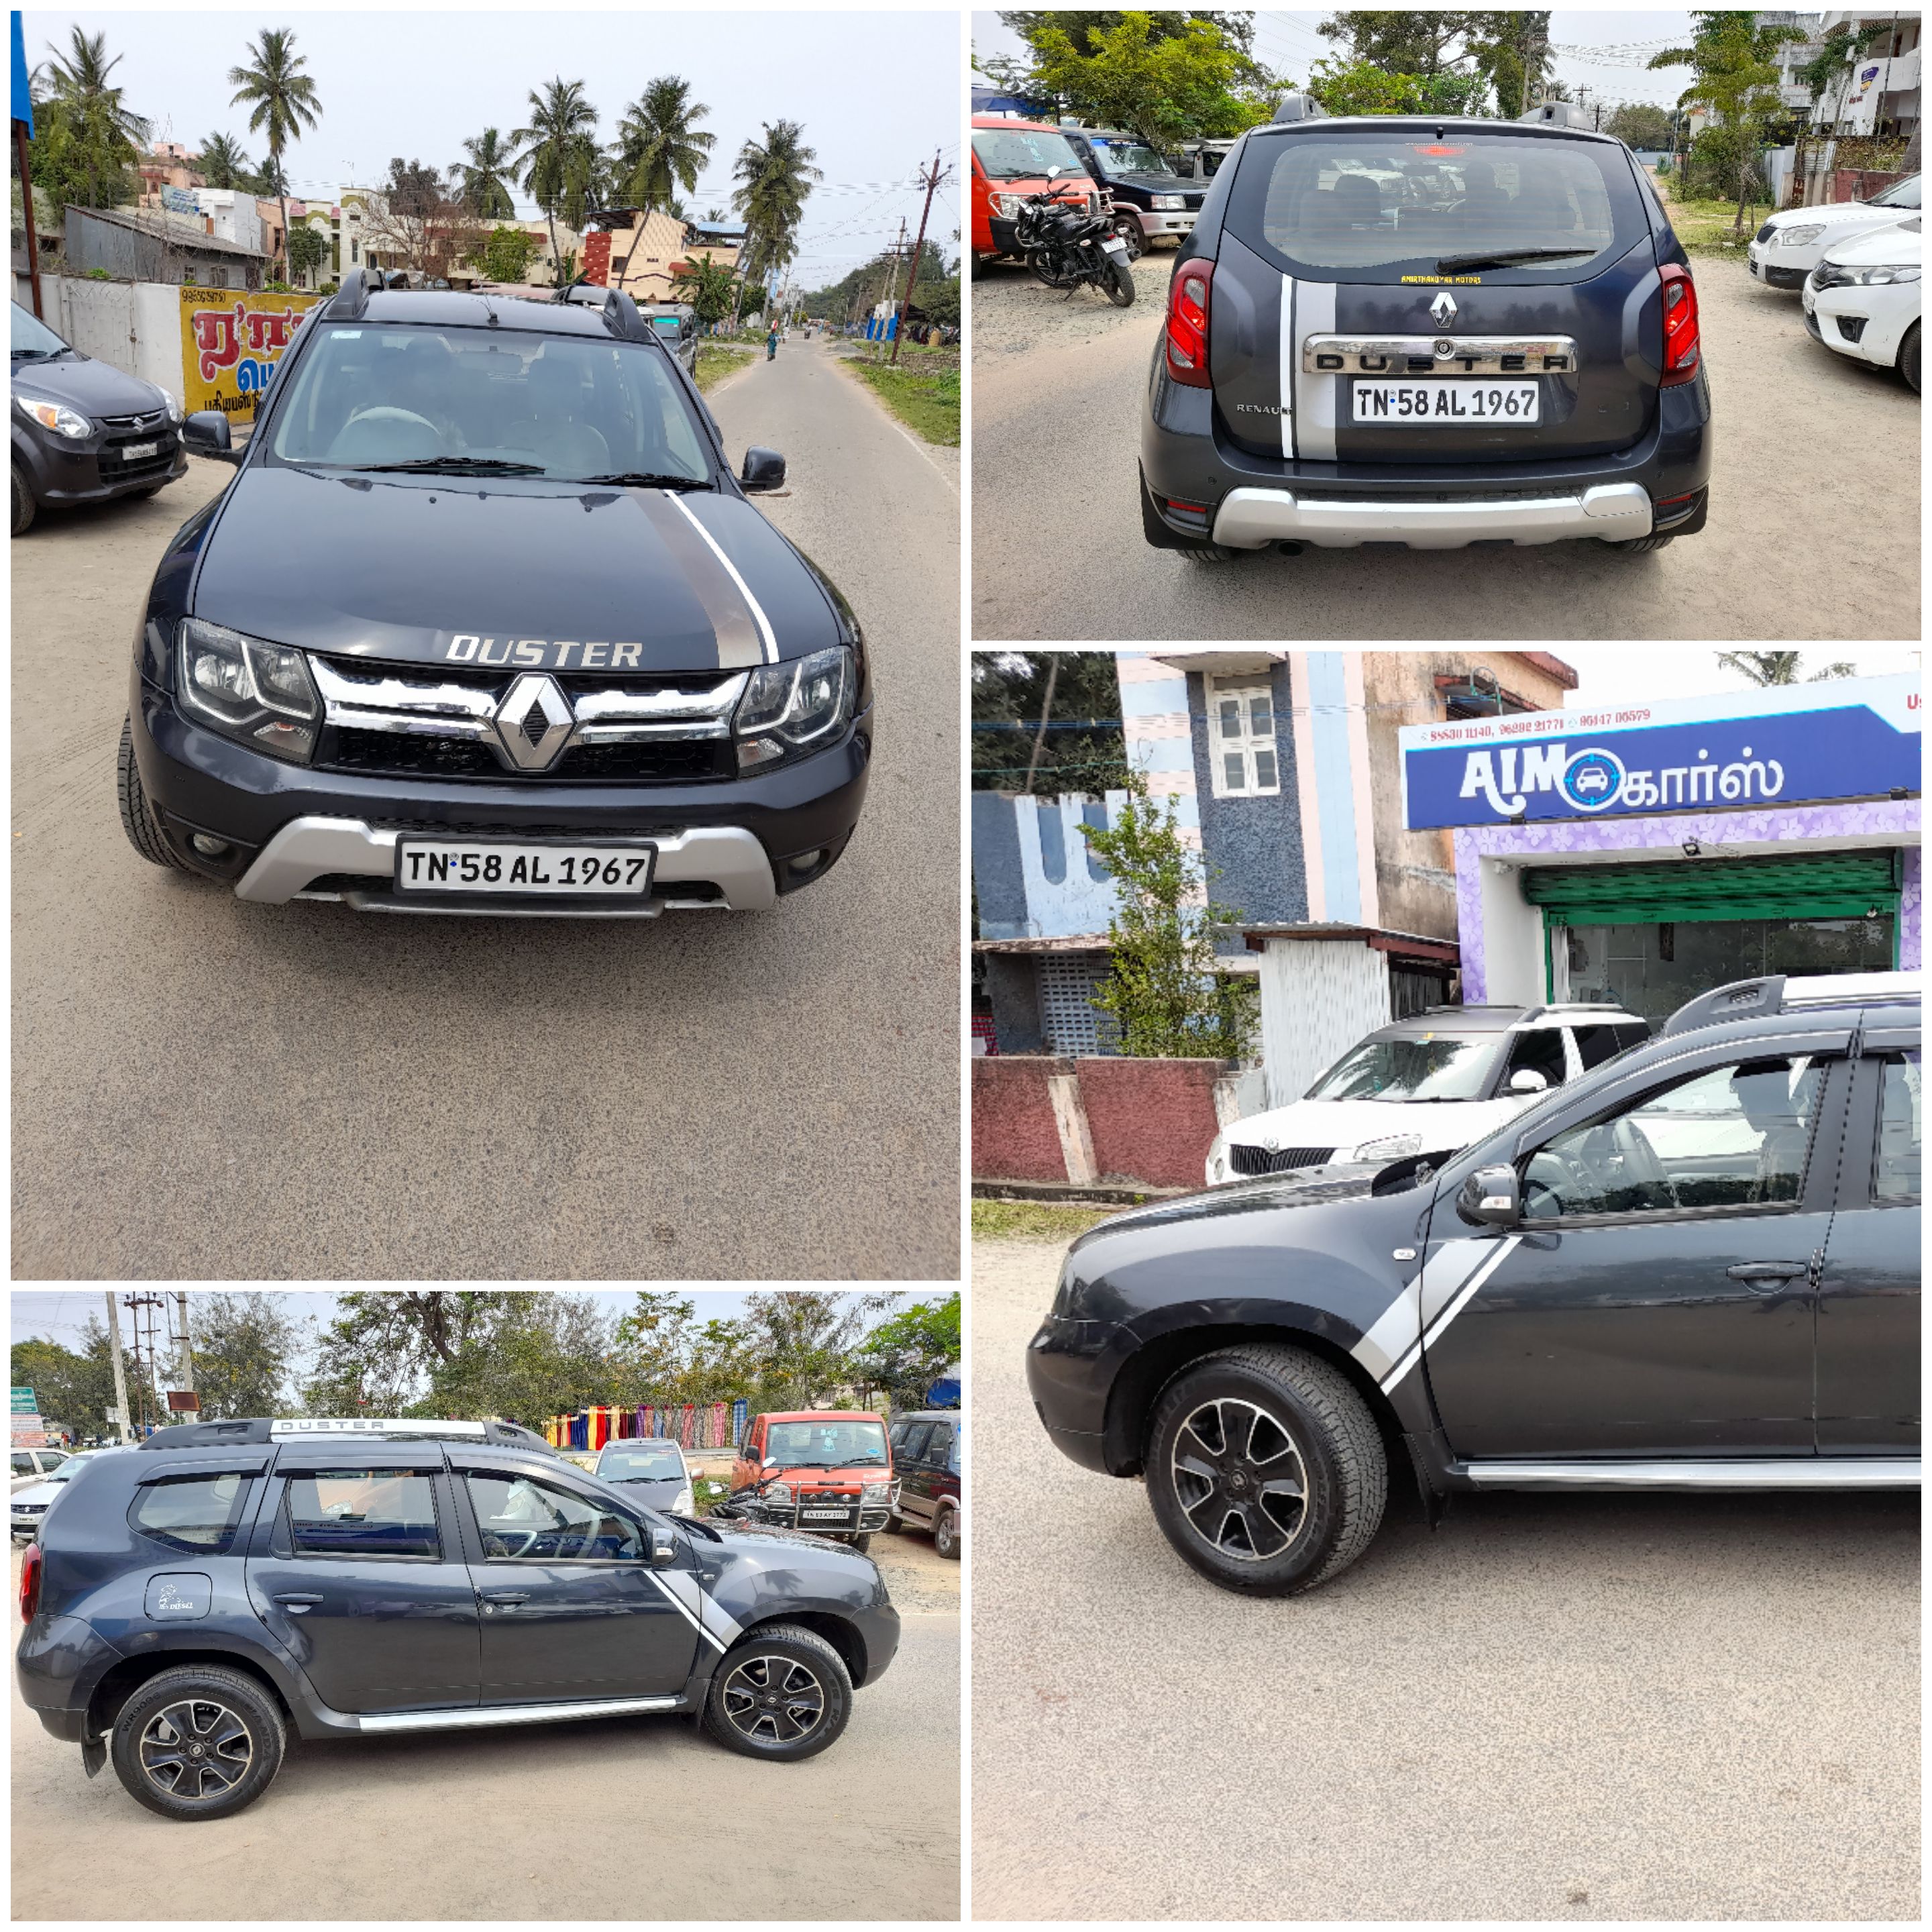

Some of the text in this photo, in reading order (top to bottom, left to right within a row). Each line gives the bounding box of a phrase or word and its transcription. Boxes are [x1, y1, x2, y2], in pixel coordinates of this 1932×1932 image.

[1455, 276, 1482, 284] MOTORS
[1316, 354, 1568, 370] DUSTER
[1236, 404, 1293, 415] RENAULT
[1357, 388, 1536, 416] TN 58 AL 1967
[445, 635, 643, 667] DUSTER
[1621, 747, 1784, 807] கார்ஸ்
[407, 852, 645, 885] TN 58 AL 1967
[280, 1421, 384, 1430] DUSTER
